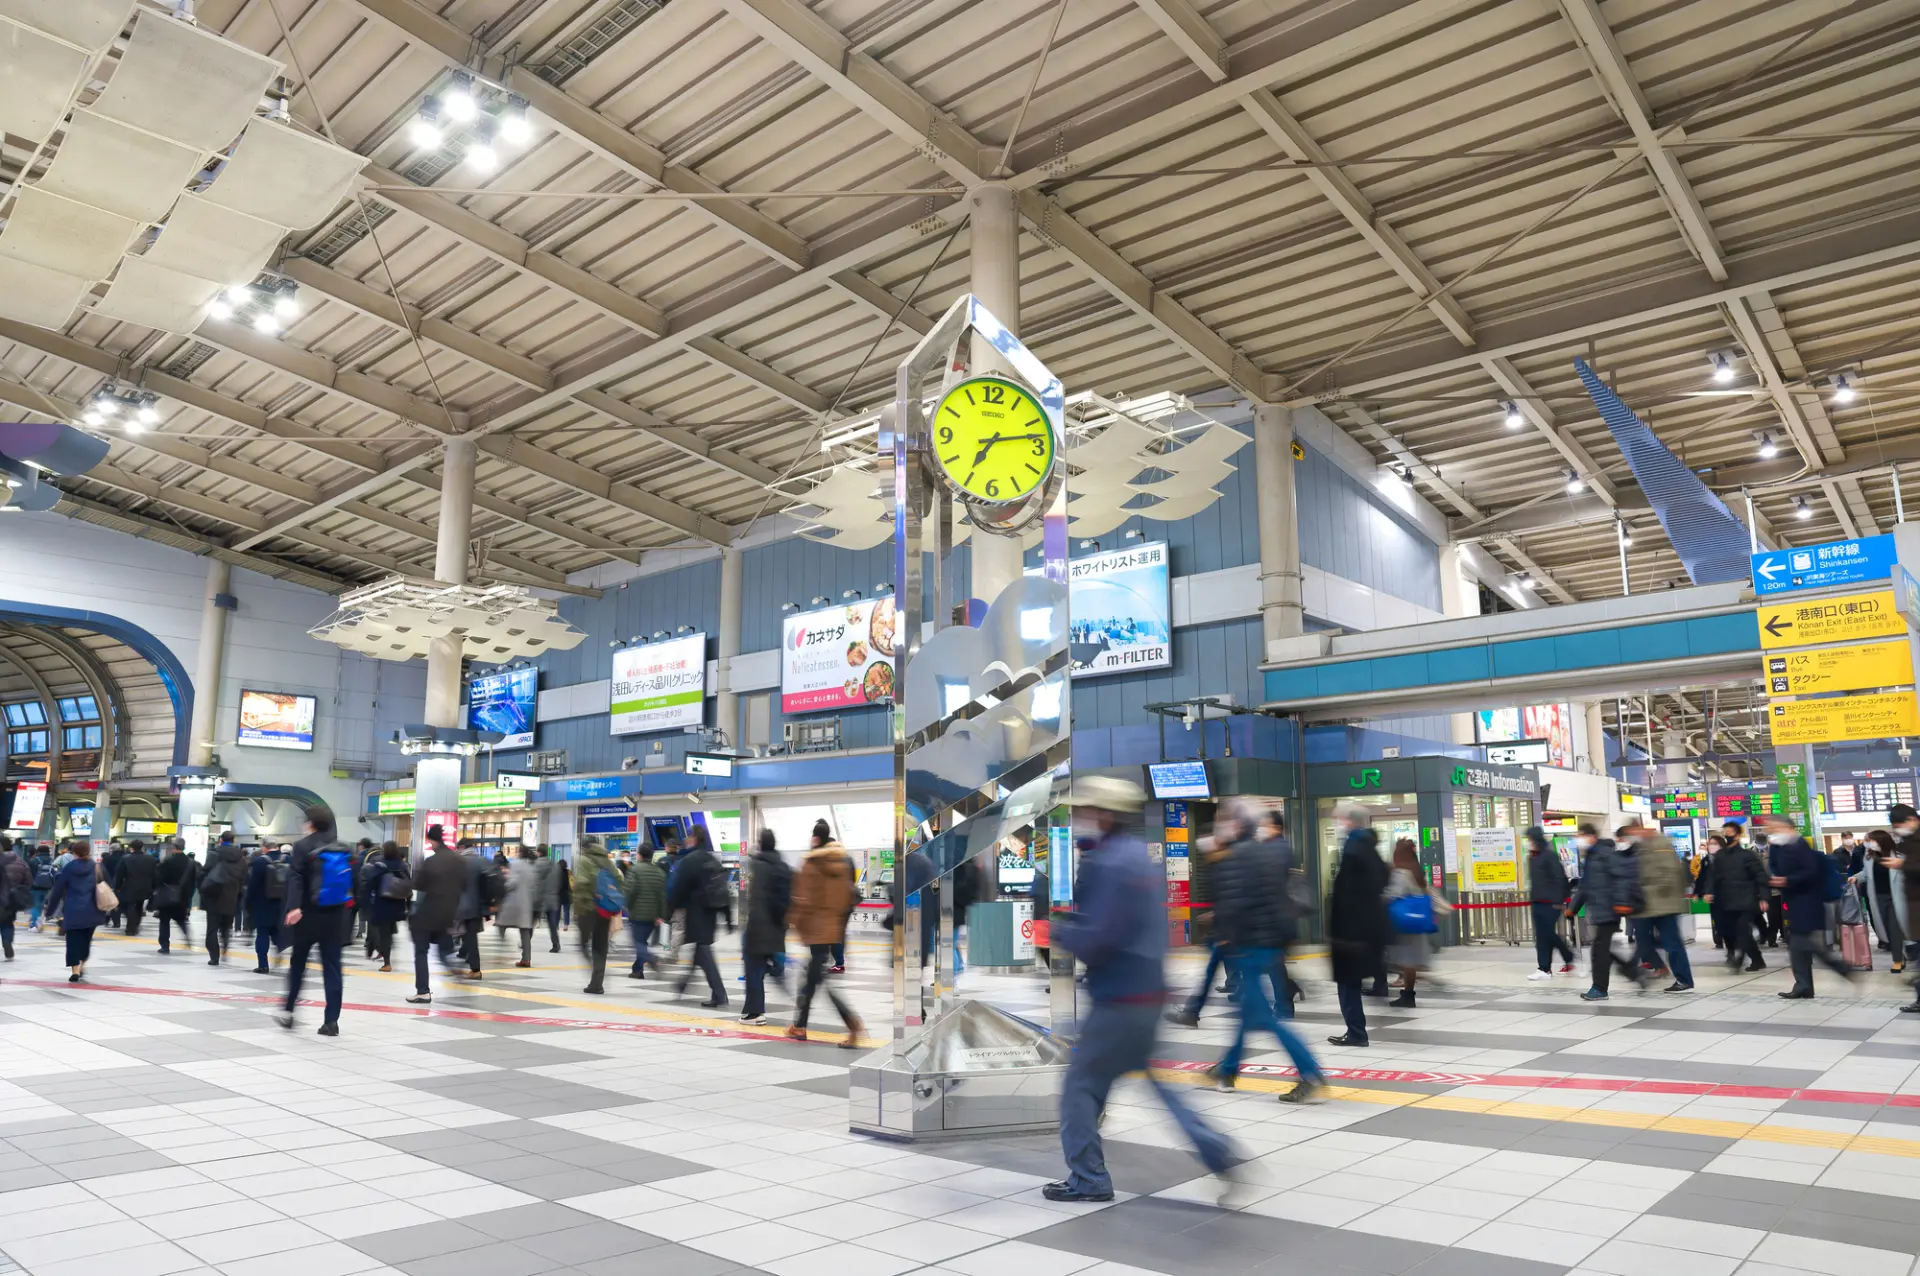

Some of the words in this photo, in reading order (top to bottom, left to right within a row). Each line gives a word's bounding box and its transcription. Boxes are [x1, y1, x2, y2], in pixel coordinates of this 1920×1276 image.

[982, 385, 1005, 405] 12
[981, 410, 1005, 419] SEIKO
[939, 426, 954, 445] 9
[1031, 437, 1046, 457] 3
[985, 478, 1000, 497] 6
[1817, 542, 1860, 560] 新幹線
[1071, 549, 1161, 577] ホワイトリスト運用
[1819, 555, 1869, 569] Shinkansen
[1762, 581, 1787, 591] 120m
[1796, 599, 1880, 622] 港南口(東口)
[1826, 618, 1842, 627] Exit
[1844, 615, 1866, 625] (East
[1868, 612, 1888, 622] Exit)
[806, 624, 846, 645] カネサダ
[1106, 647, 1164, 667] m-FILTER
[1790, 655, 1810, 665] バス
[612, 671, 704, 697] 浅田レディース品川クリニック
[1792, 674, 1831, 685] タクシー
[1776, 718, 1797, 728] atré
[1350, 768, 1381, 789] JR
[1781, 765, 1801, 774] JR
[1451, 766, 1466, 786] JR
[1466, 768, 1490, 788] ご案内
[1491, 771, 1535, 793] Information
[1787, 778, 1799, 804] 品川駅
